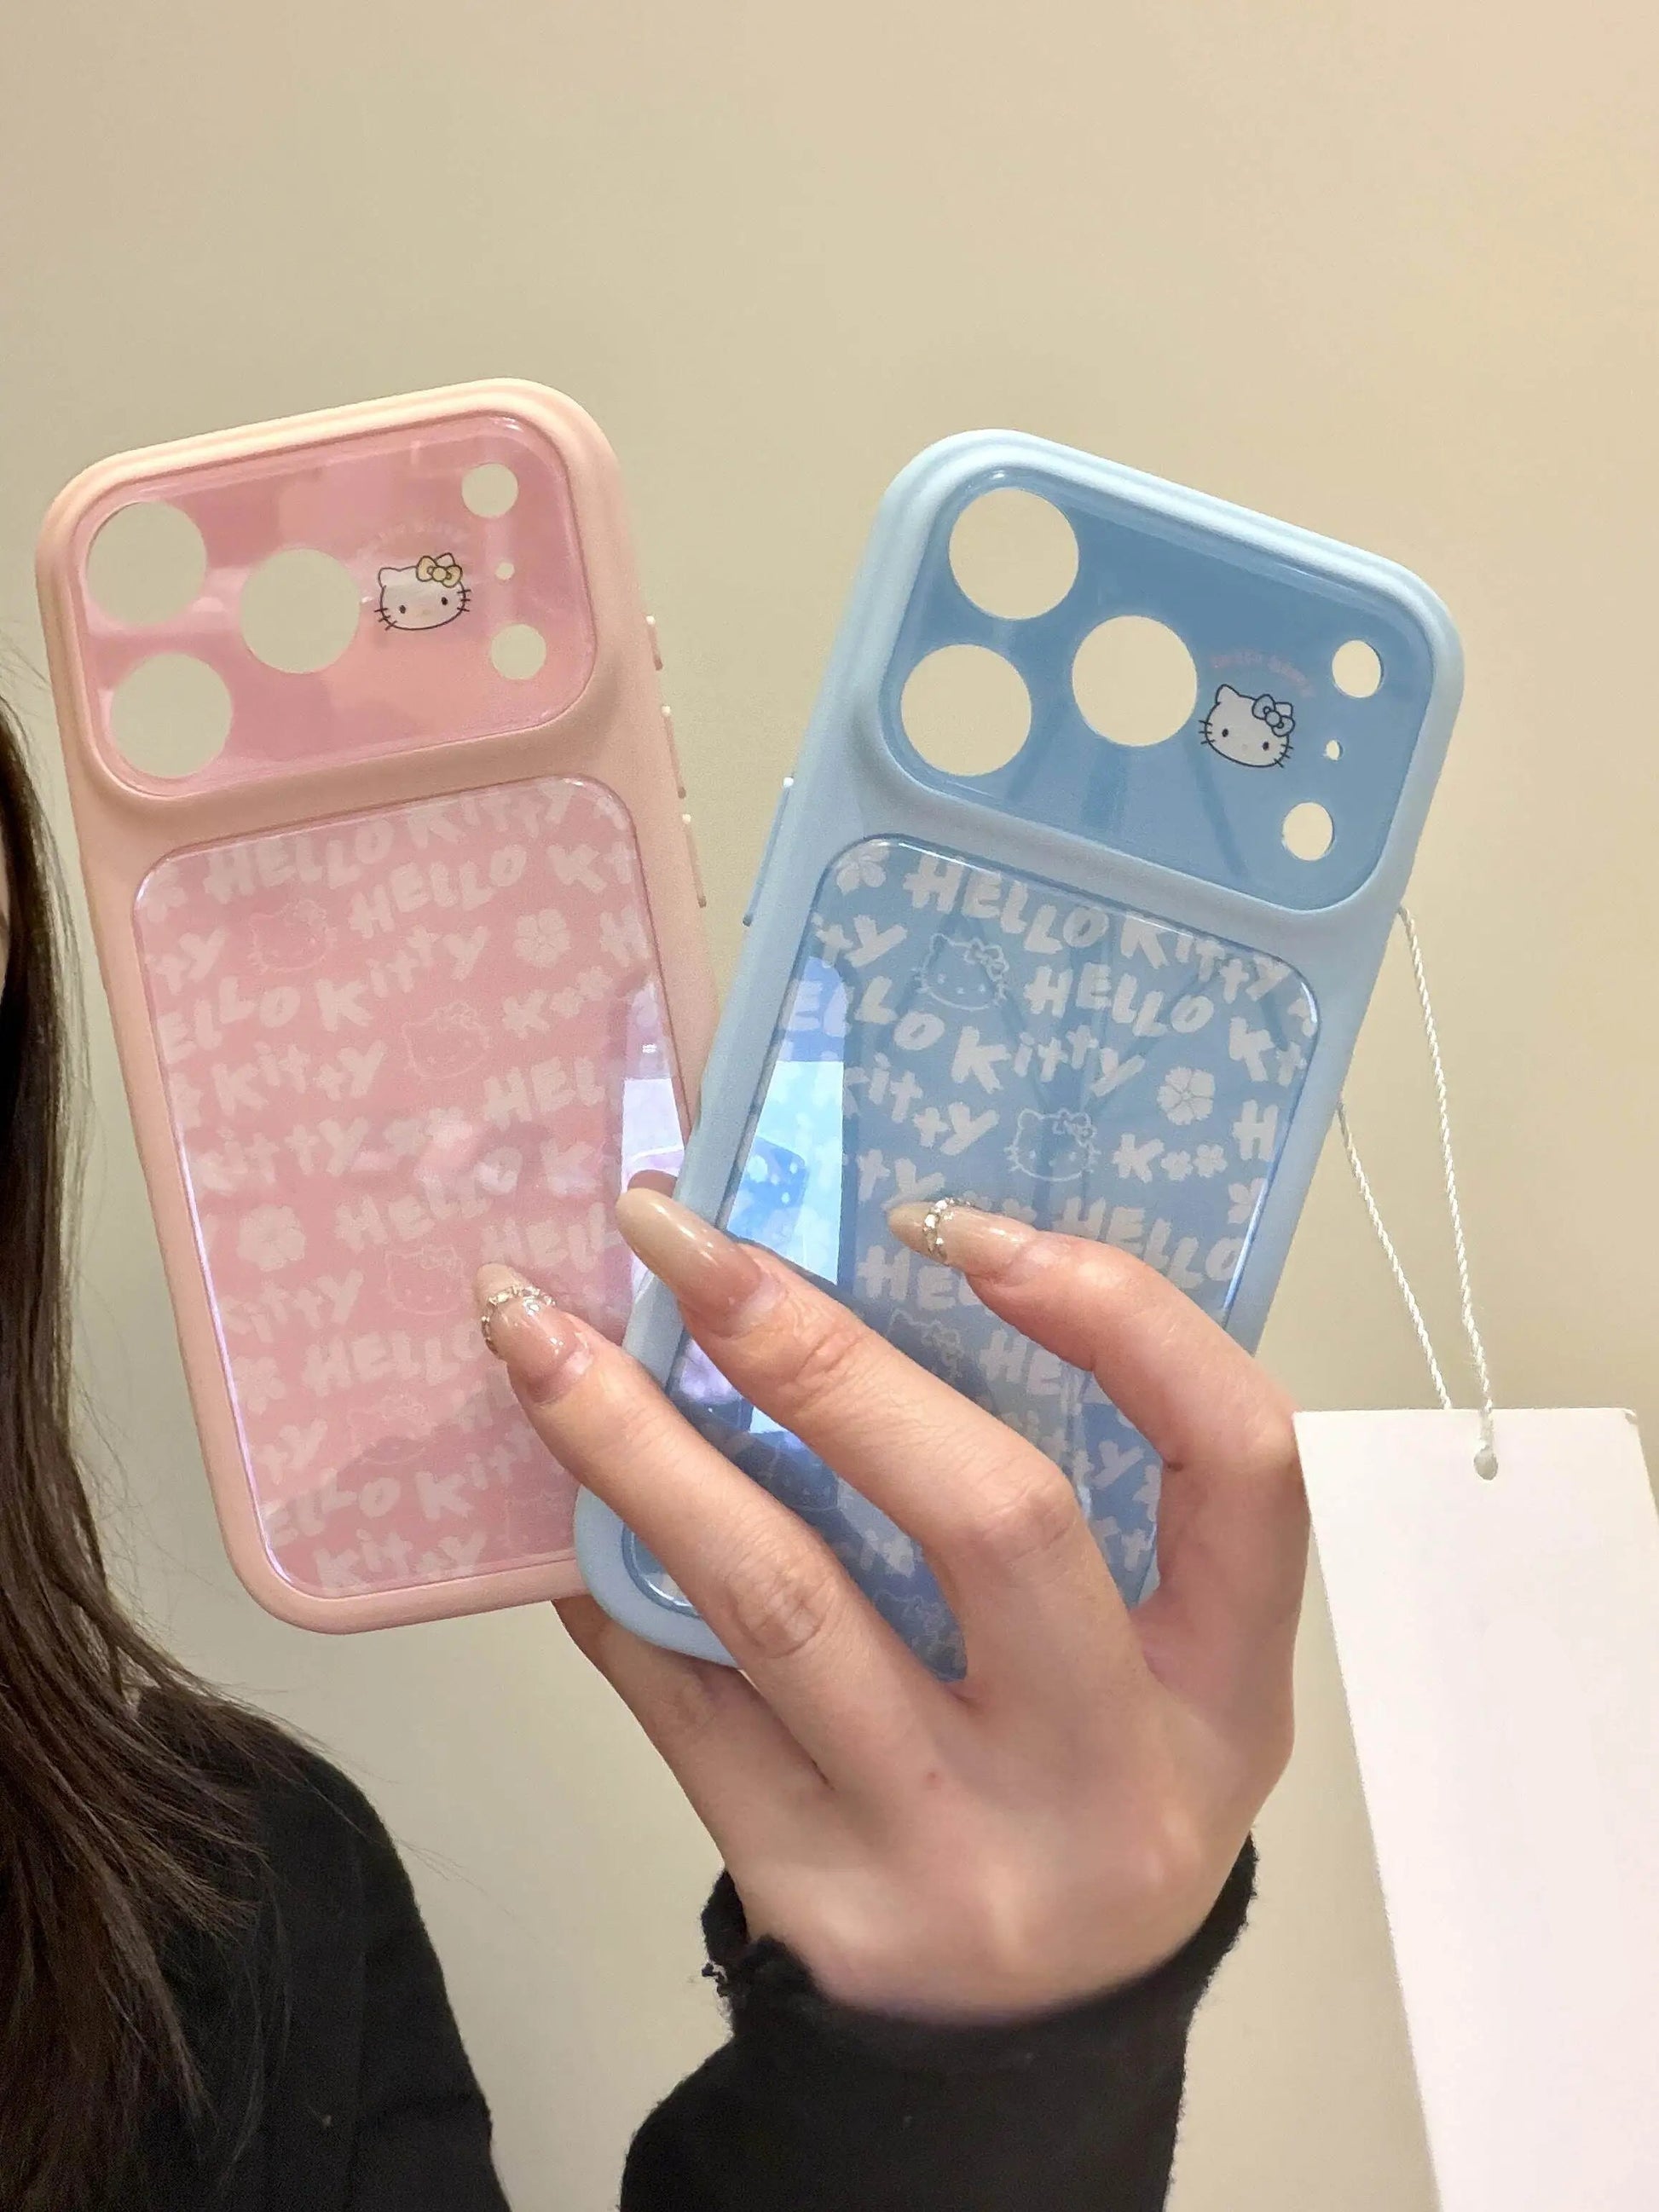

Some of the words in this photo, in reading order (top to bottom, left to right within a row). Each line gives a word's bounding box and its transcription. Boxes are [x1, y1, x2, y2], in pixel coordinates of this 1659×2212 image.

[348, 844, 528, 939] HELLO
[903, 852, 1109, 955] HELLO
[1023, 962, 1215, 1037] HELLO
